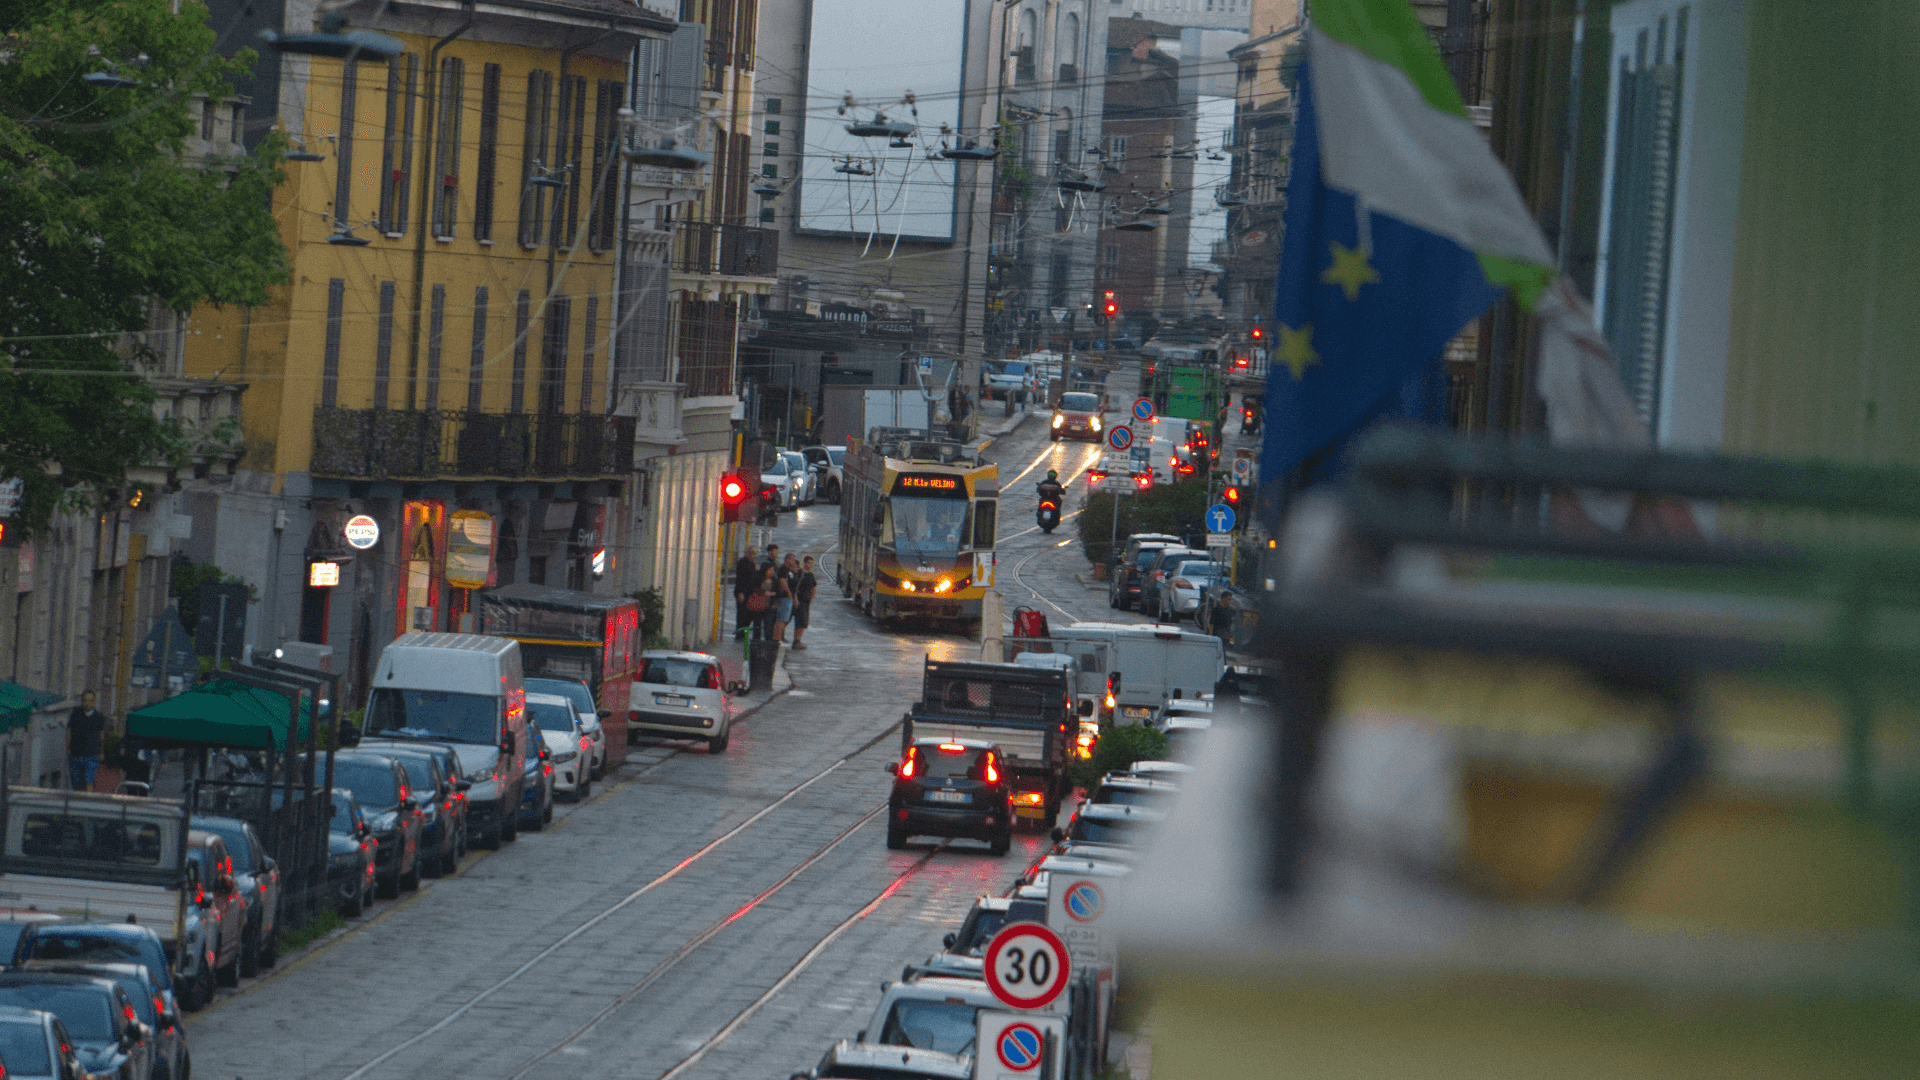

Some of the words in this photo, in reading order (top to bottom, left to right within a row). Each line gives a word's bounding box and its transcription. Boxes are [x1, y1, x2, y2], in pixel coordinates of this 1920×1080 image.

[903, 477, 912, 486] 12
[930, 480, 955, 488] VELINO
[1005, 947, 1051, 986] 30
